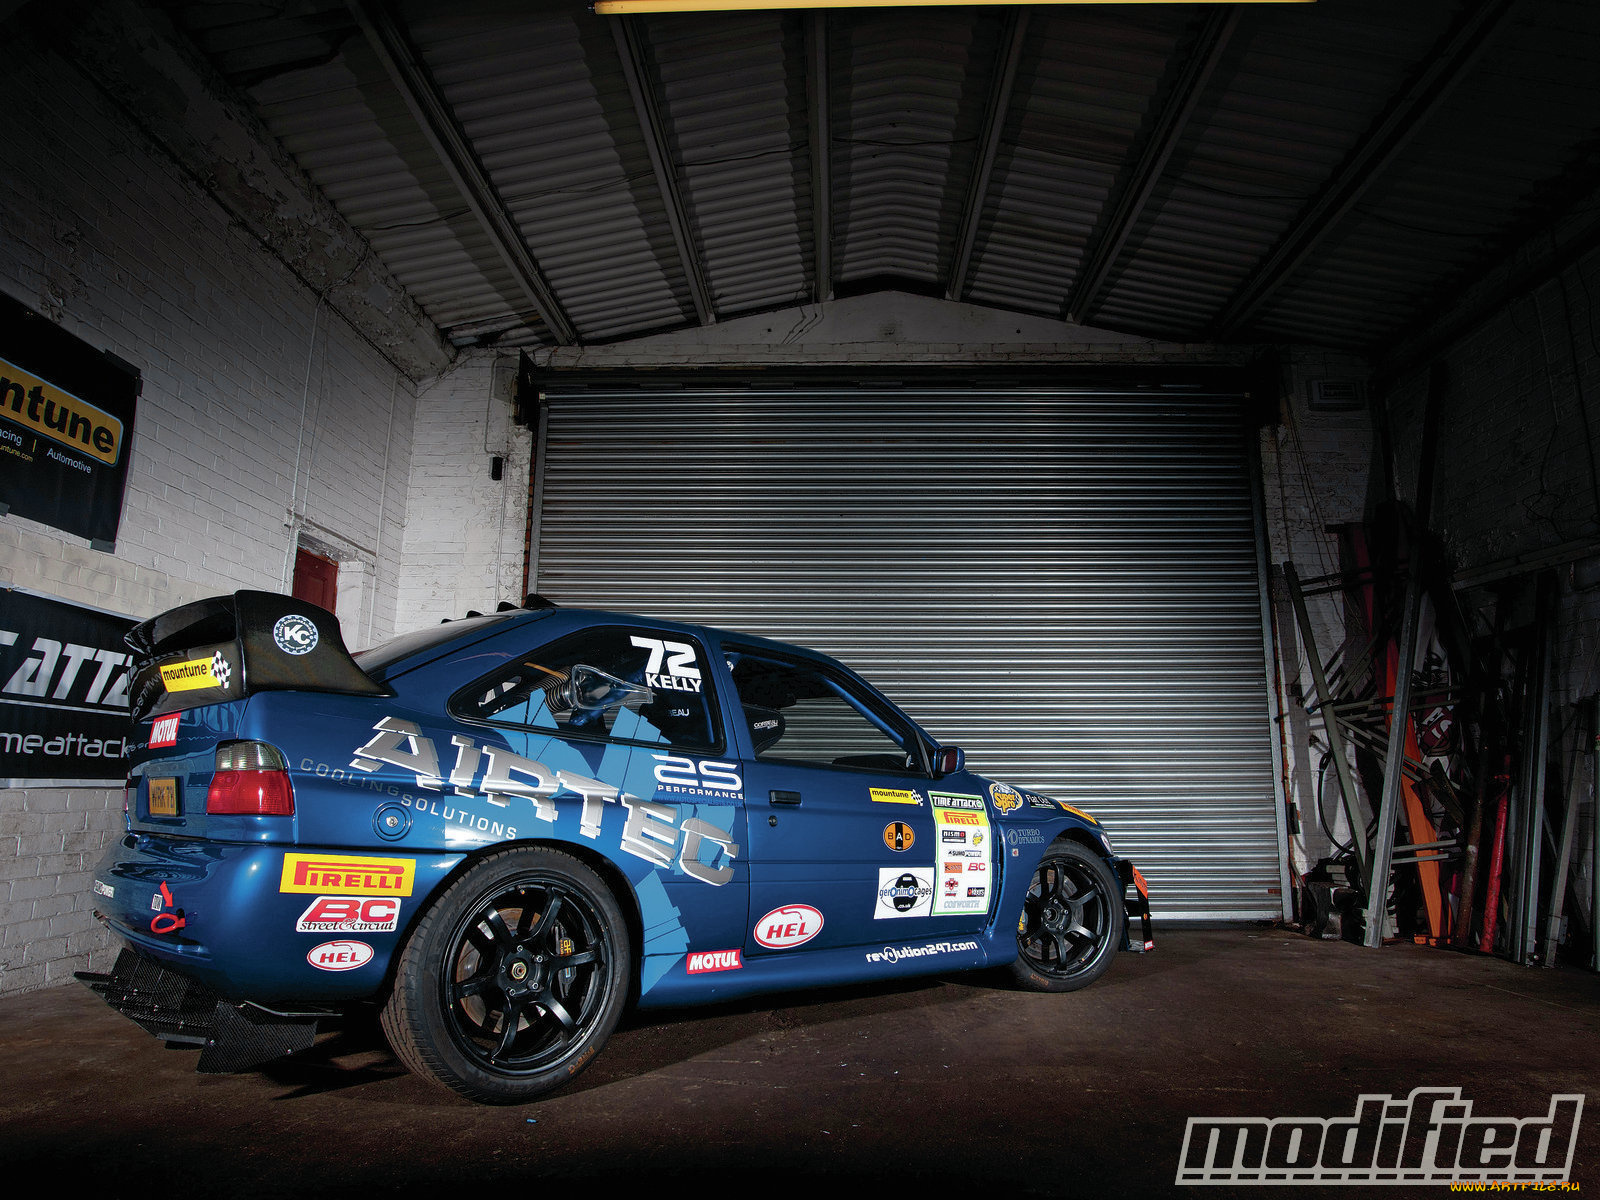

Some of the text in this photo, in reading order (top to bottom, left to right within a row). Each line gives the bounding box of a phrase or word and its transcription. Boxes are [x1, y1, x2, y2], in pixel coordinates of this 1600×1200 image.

[47, 448, 92, 474] Automotive
[284, 624, 311, 645] KC
[630, 635, 702, 679] 72
[163, 661, 208, 683] mountune
[645, 672, 702, 693] KELLY
[150, 717, 179, 744] MOTUL
[349, 715, 739, 887] AIRTEC
[657, 784, 744, 800] PERFORMANCE
[871, 789, 909, 799] mountune
[932, 796, 952, 807] TIME
[943, 811, 980, 826] PIRELLI
[887, 832, 912, 841] BAD
[1018, 828, 1041, 837] TURBO
[1018, 836, 1045, 845] DYNAMICS
[293, 861, 405, 890] PIRELLI
[967, 862, 986, 872] BC
[302, 899, 396, 923] BC
[766, 921, 809, 940] HEL
[319, 951, 361, 964] HEL
[689, 951, 739, 971] MOTUL
